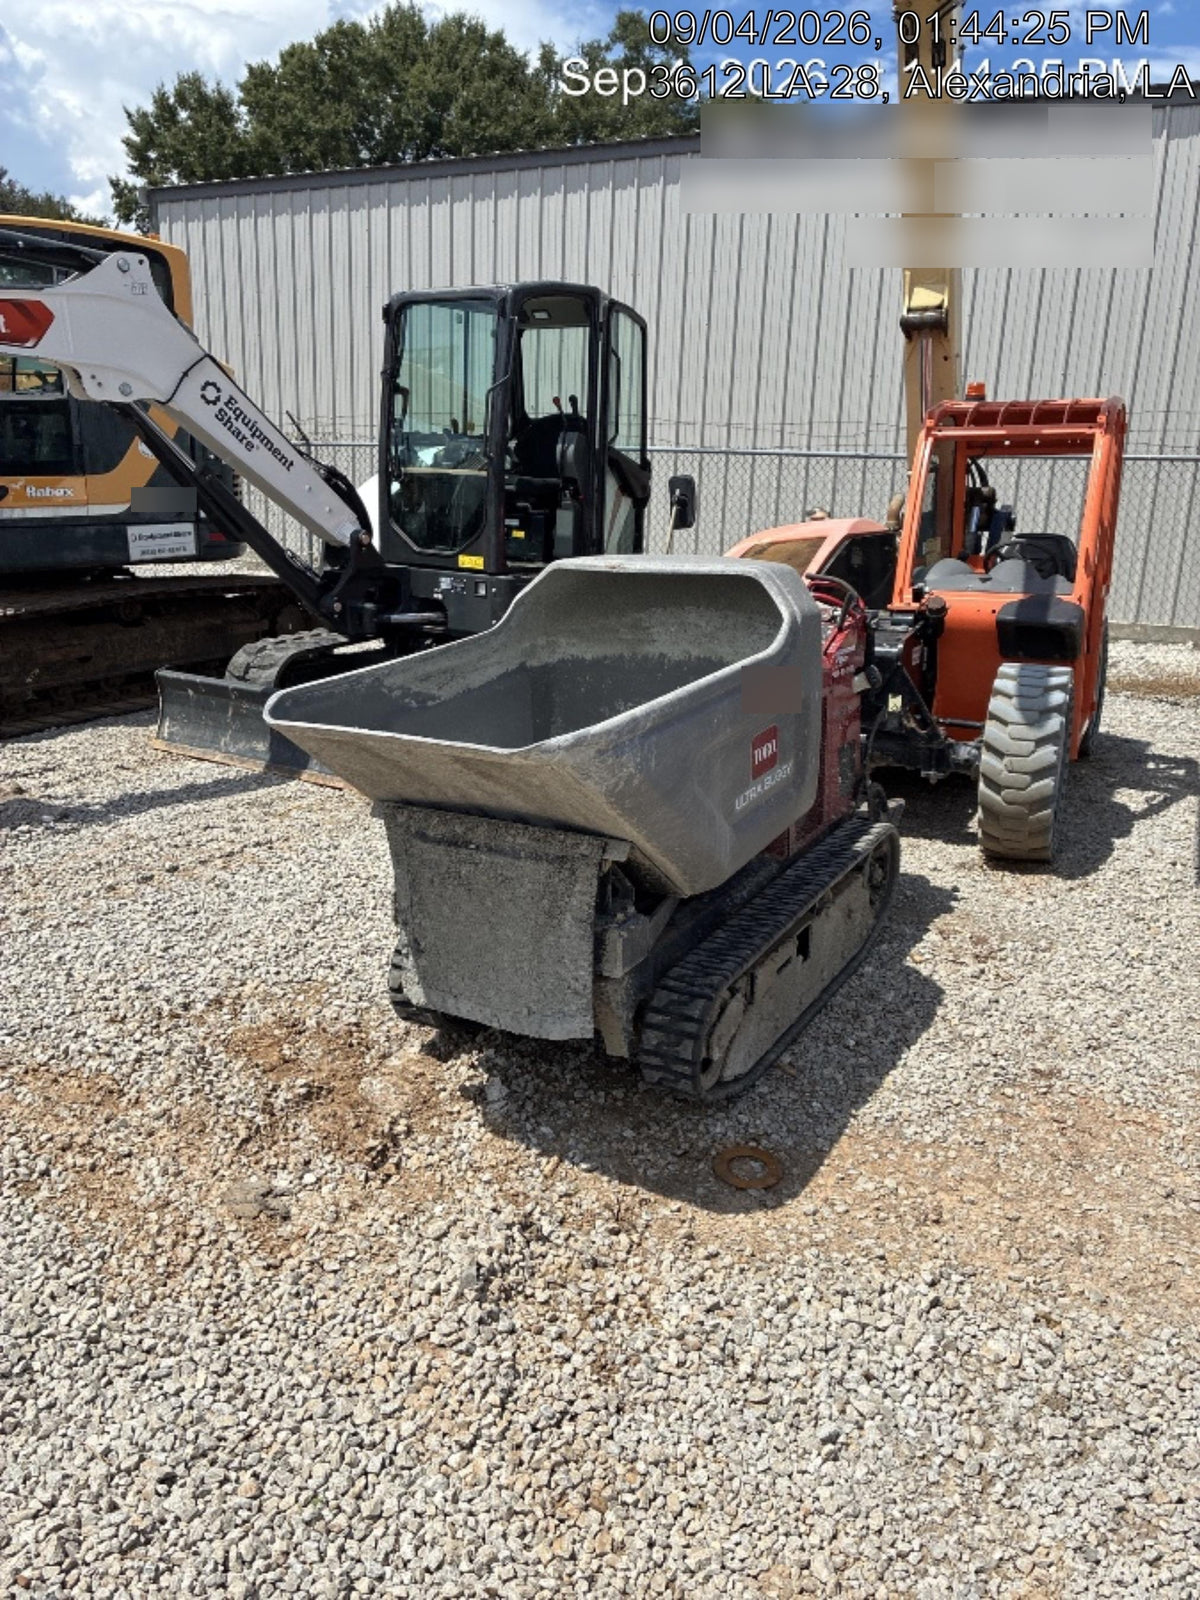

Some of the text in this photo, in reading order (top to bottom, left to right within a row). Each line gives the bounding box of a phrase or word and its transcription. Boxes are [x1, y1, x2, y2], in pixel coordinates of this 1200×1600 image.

[214, 408, 255, 452] Share
[223, 394, 294, 472] Equipment
[735, 784, 763, 810] ULTRA
